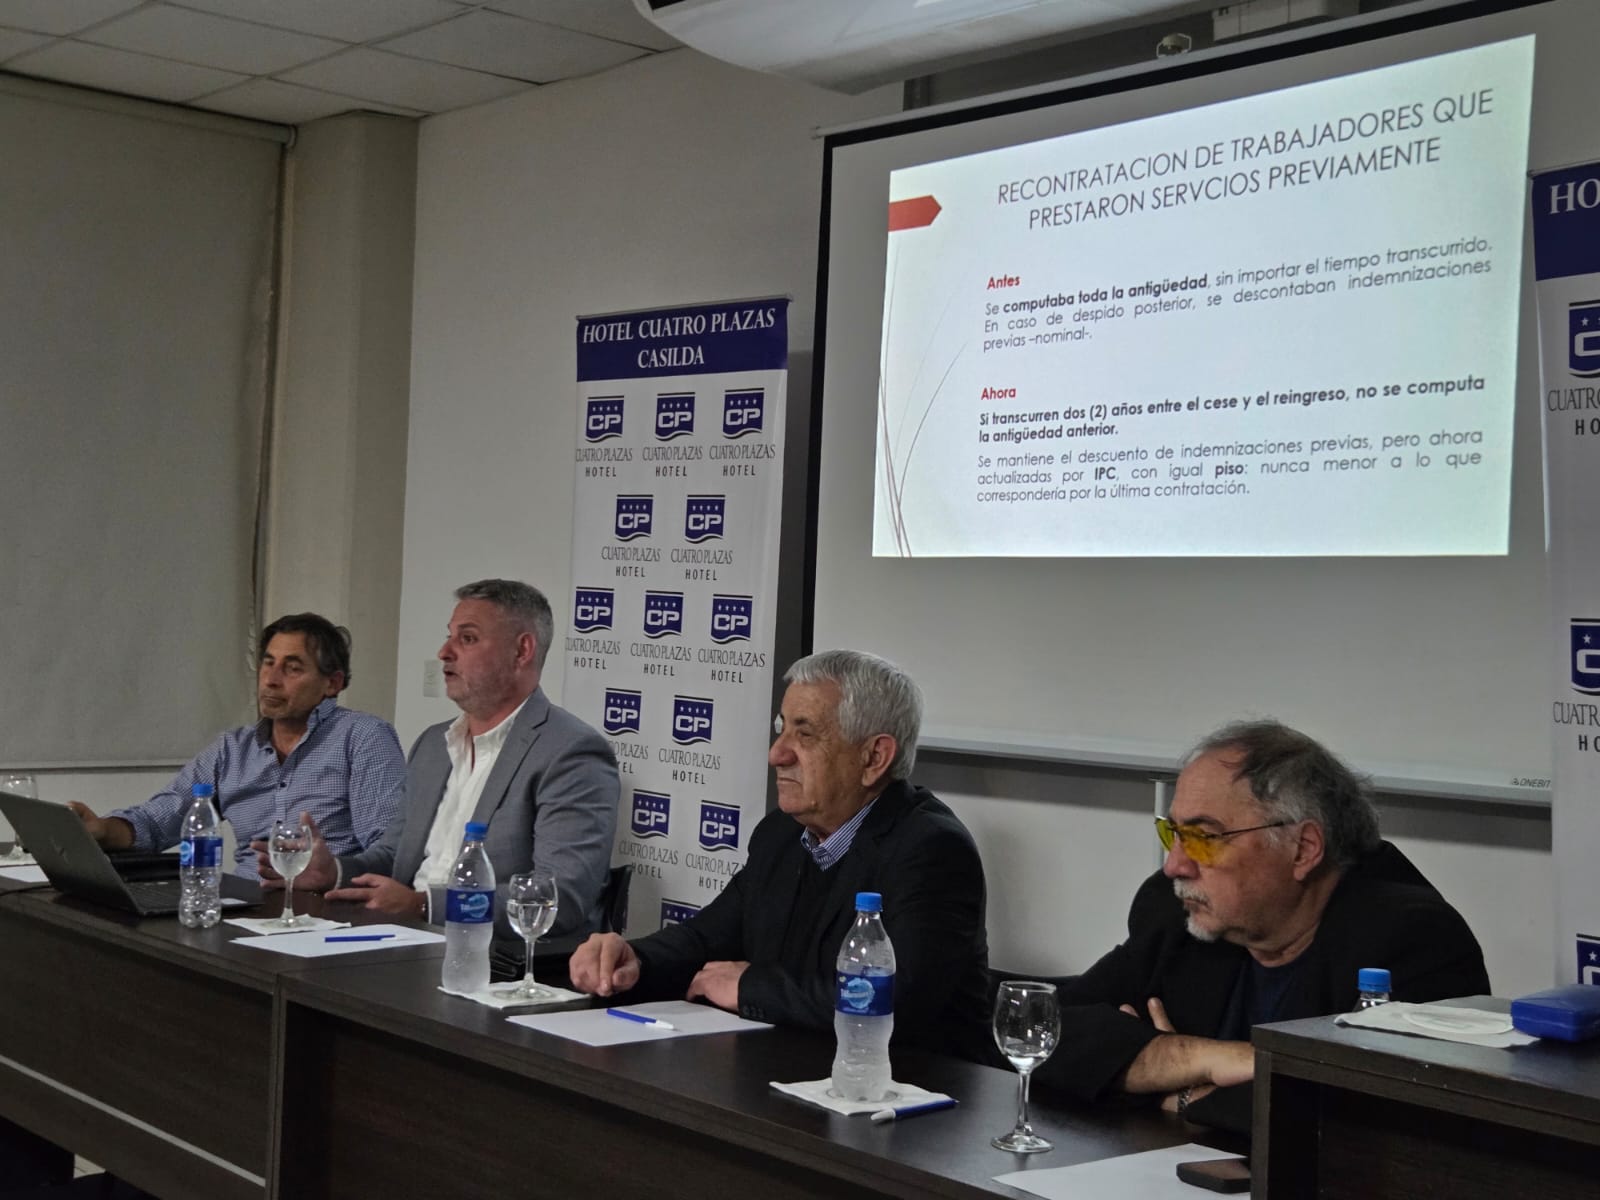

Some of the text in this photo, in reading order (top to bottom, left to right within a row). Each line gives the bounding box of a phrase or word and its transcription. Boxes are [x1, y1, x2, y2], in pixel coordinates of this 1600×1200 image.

[998, 88, 1493, 204] RECONTRATACION DE TRABAJADORES QUE
[1030, 137, 1440, 230] PRESTARON SERVCIOS PREVIAMENTE
[985, 237, 1492, 316] Se computaba toda la antigüedad, sin importar el tiempo transcurrido.
[987, 274, 1020, 290] Antes
[985, 260, 1491, 333] En caso de despido posterior, se descontaban indemnizaciones
[583, 307, 776, 343] HOTEL CUATRO PLAZAS
[984, 334, 1026, 353] previas
[637, 345, 705, 368] CASILDA
[980, 374, 1485, 426] Si transcurren dos (2) años entre el cese y el reingreso, no se computa
[981, 387, 1016, 400] Ahora
[1548, 387, 1600, 411] CUATR
[587, 414, 621, 432] CP
[657, 410, 694, 429] CP
[724, 407, 761, 426] CP
[979, 422, 1118, 444] la antigüedad anterior.
[978, 430, 1483, 468] Se mantiene el descuento de indemnizaciones previas, pero ahora
[585, 466, 617, 478] HOTEL
[655, 465, 688, 477] HOTEL
[722, 464, 756, 477] HOTEL
[978, 452, 1482, 485] actualizadas por IPC, con igual piso: nunca menor a lo que
[977, 480, 1249, 504] correspondería por la última contratación.
[617, 512, 650, 529] CP
[687, 512, 722, 530] CP
[615, 566, 646, 579] HOTEL
[685, 568, 718, 582] HOTEL
[575, 605, 611, 622] CP
[646, 609, 680, 627] CP
[713, 612, 749, 631] CP
[574, 657, 607, 670] HOTEL
[643, 663, 675, 677] HOTEL
[711, 670, 744, 684] HOTEL
[605, 706, 639, 724] CP
[675, 715, 710, 733] CP
[672, 770, 706, 785] HOTEL
[633, 808, 667, 826] CP
[701, 822, 736, 840] CP
